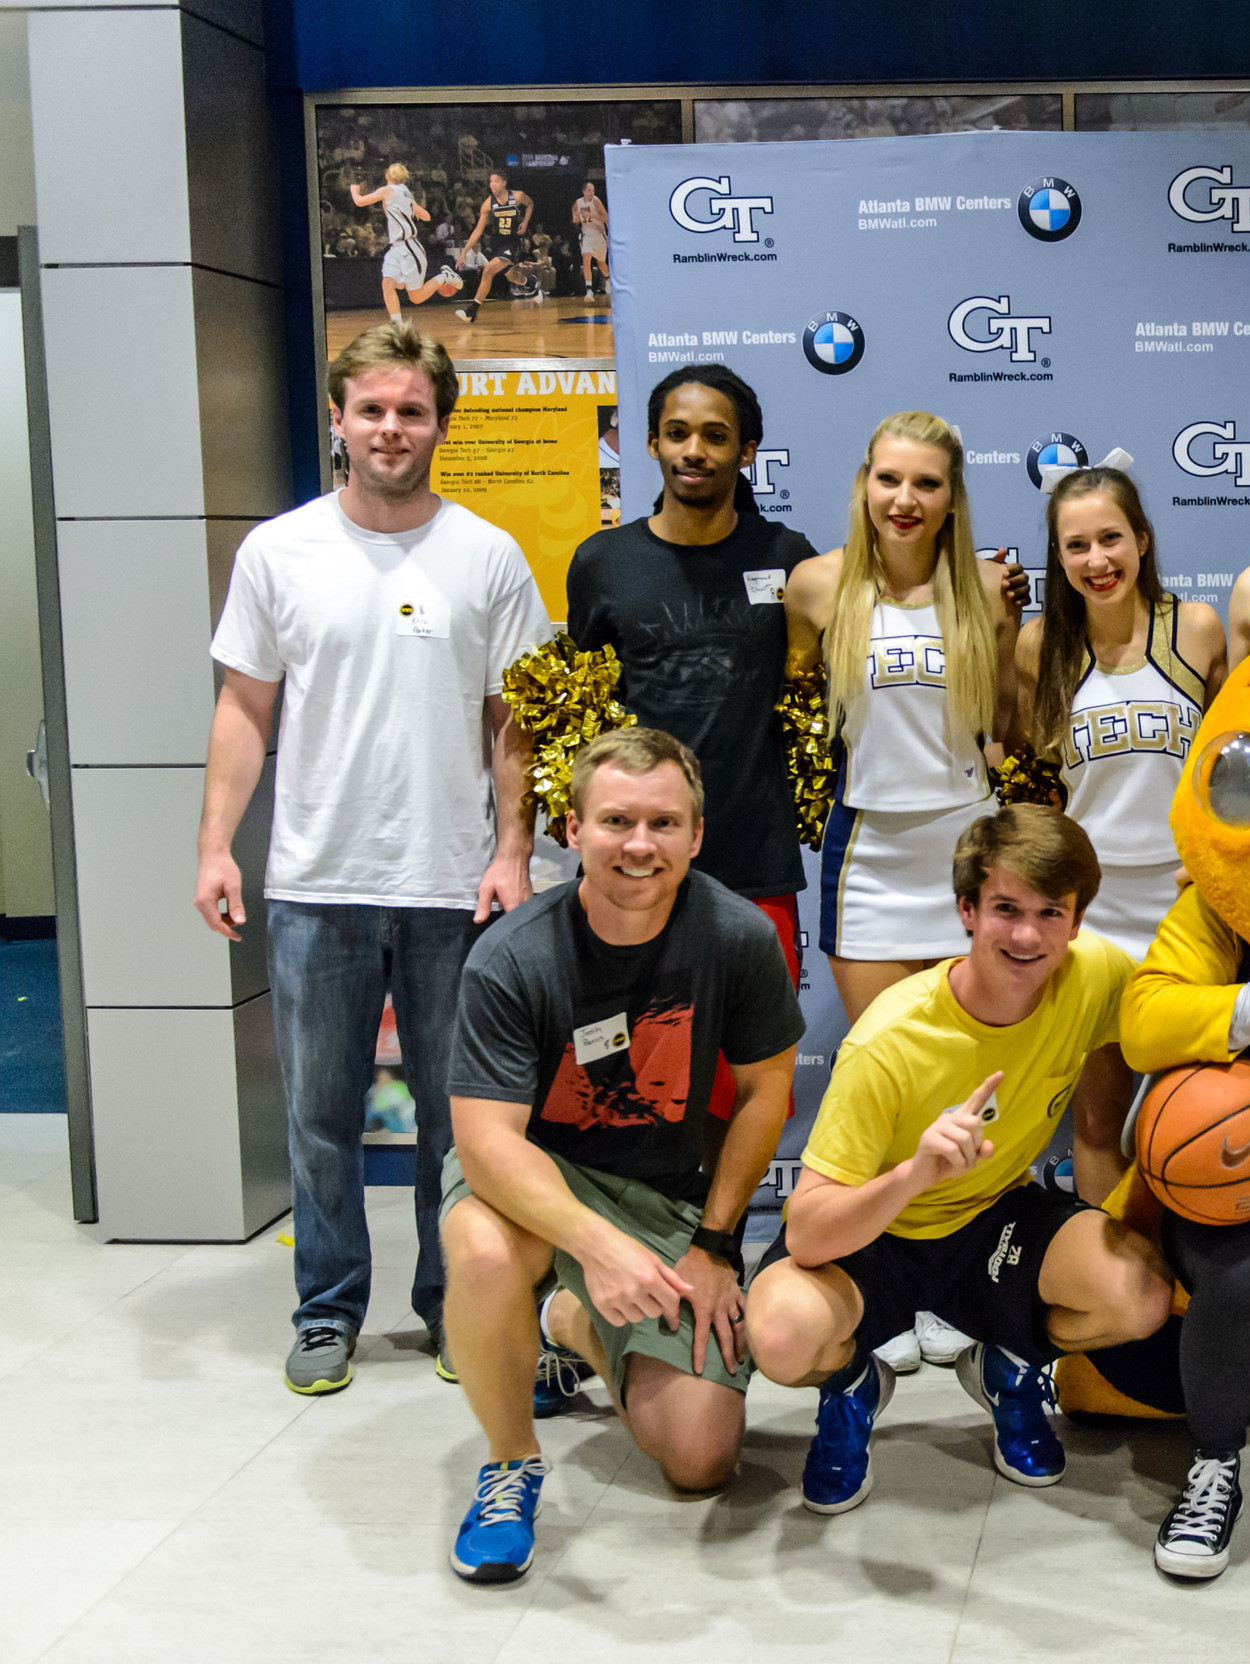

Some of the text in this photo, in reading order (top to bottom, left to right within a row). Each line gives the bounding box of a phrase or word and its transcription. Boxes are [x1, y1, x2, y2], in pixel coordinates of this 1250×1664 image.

[1024, 178, 1076, 198] BMW
[670, 176, 773, 243] GT
[858, 195, 1012, 215] Atlanta BMW Centers
[858, 216, 937, 230] BMWatl.com
[673, 252, 777, 264] RamblinWreck.com
[807, 312, 859, 332] BMW
[947, 295, 1051, 363] GT
[1135, 321, 1187, 337] Atlanta
[1193, 321, 1230, 337] BMW
[648, 329, 796, 347] Atlanta BMW Centers
[1135, 341, 1213, 353] BMWatl.com
[648, 350, 724, 363] BMWatl.com
[456, 371, 616, 396] URT ADVAN
[949, 372, 1053, 383] RamblinWreck.com
[1032, 433, 1082, 453] BMW
[966, 450, 1020, 465] Centers
[1197, 573, 1234, 587] BMW
[1179, 592, 1218, 602] tl.com
[871, 635, 946, 689] EC
